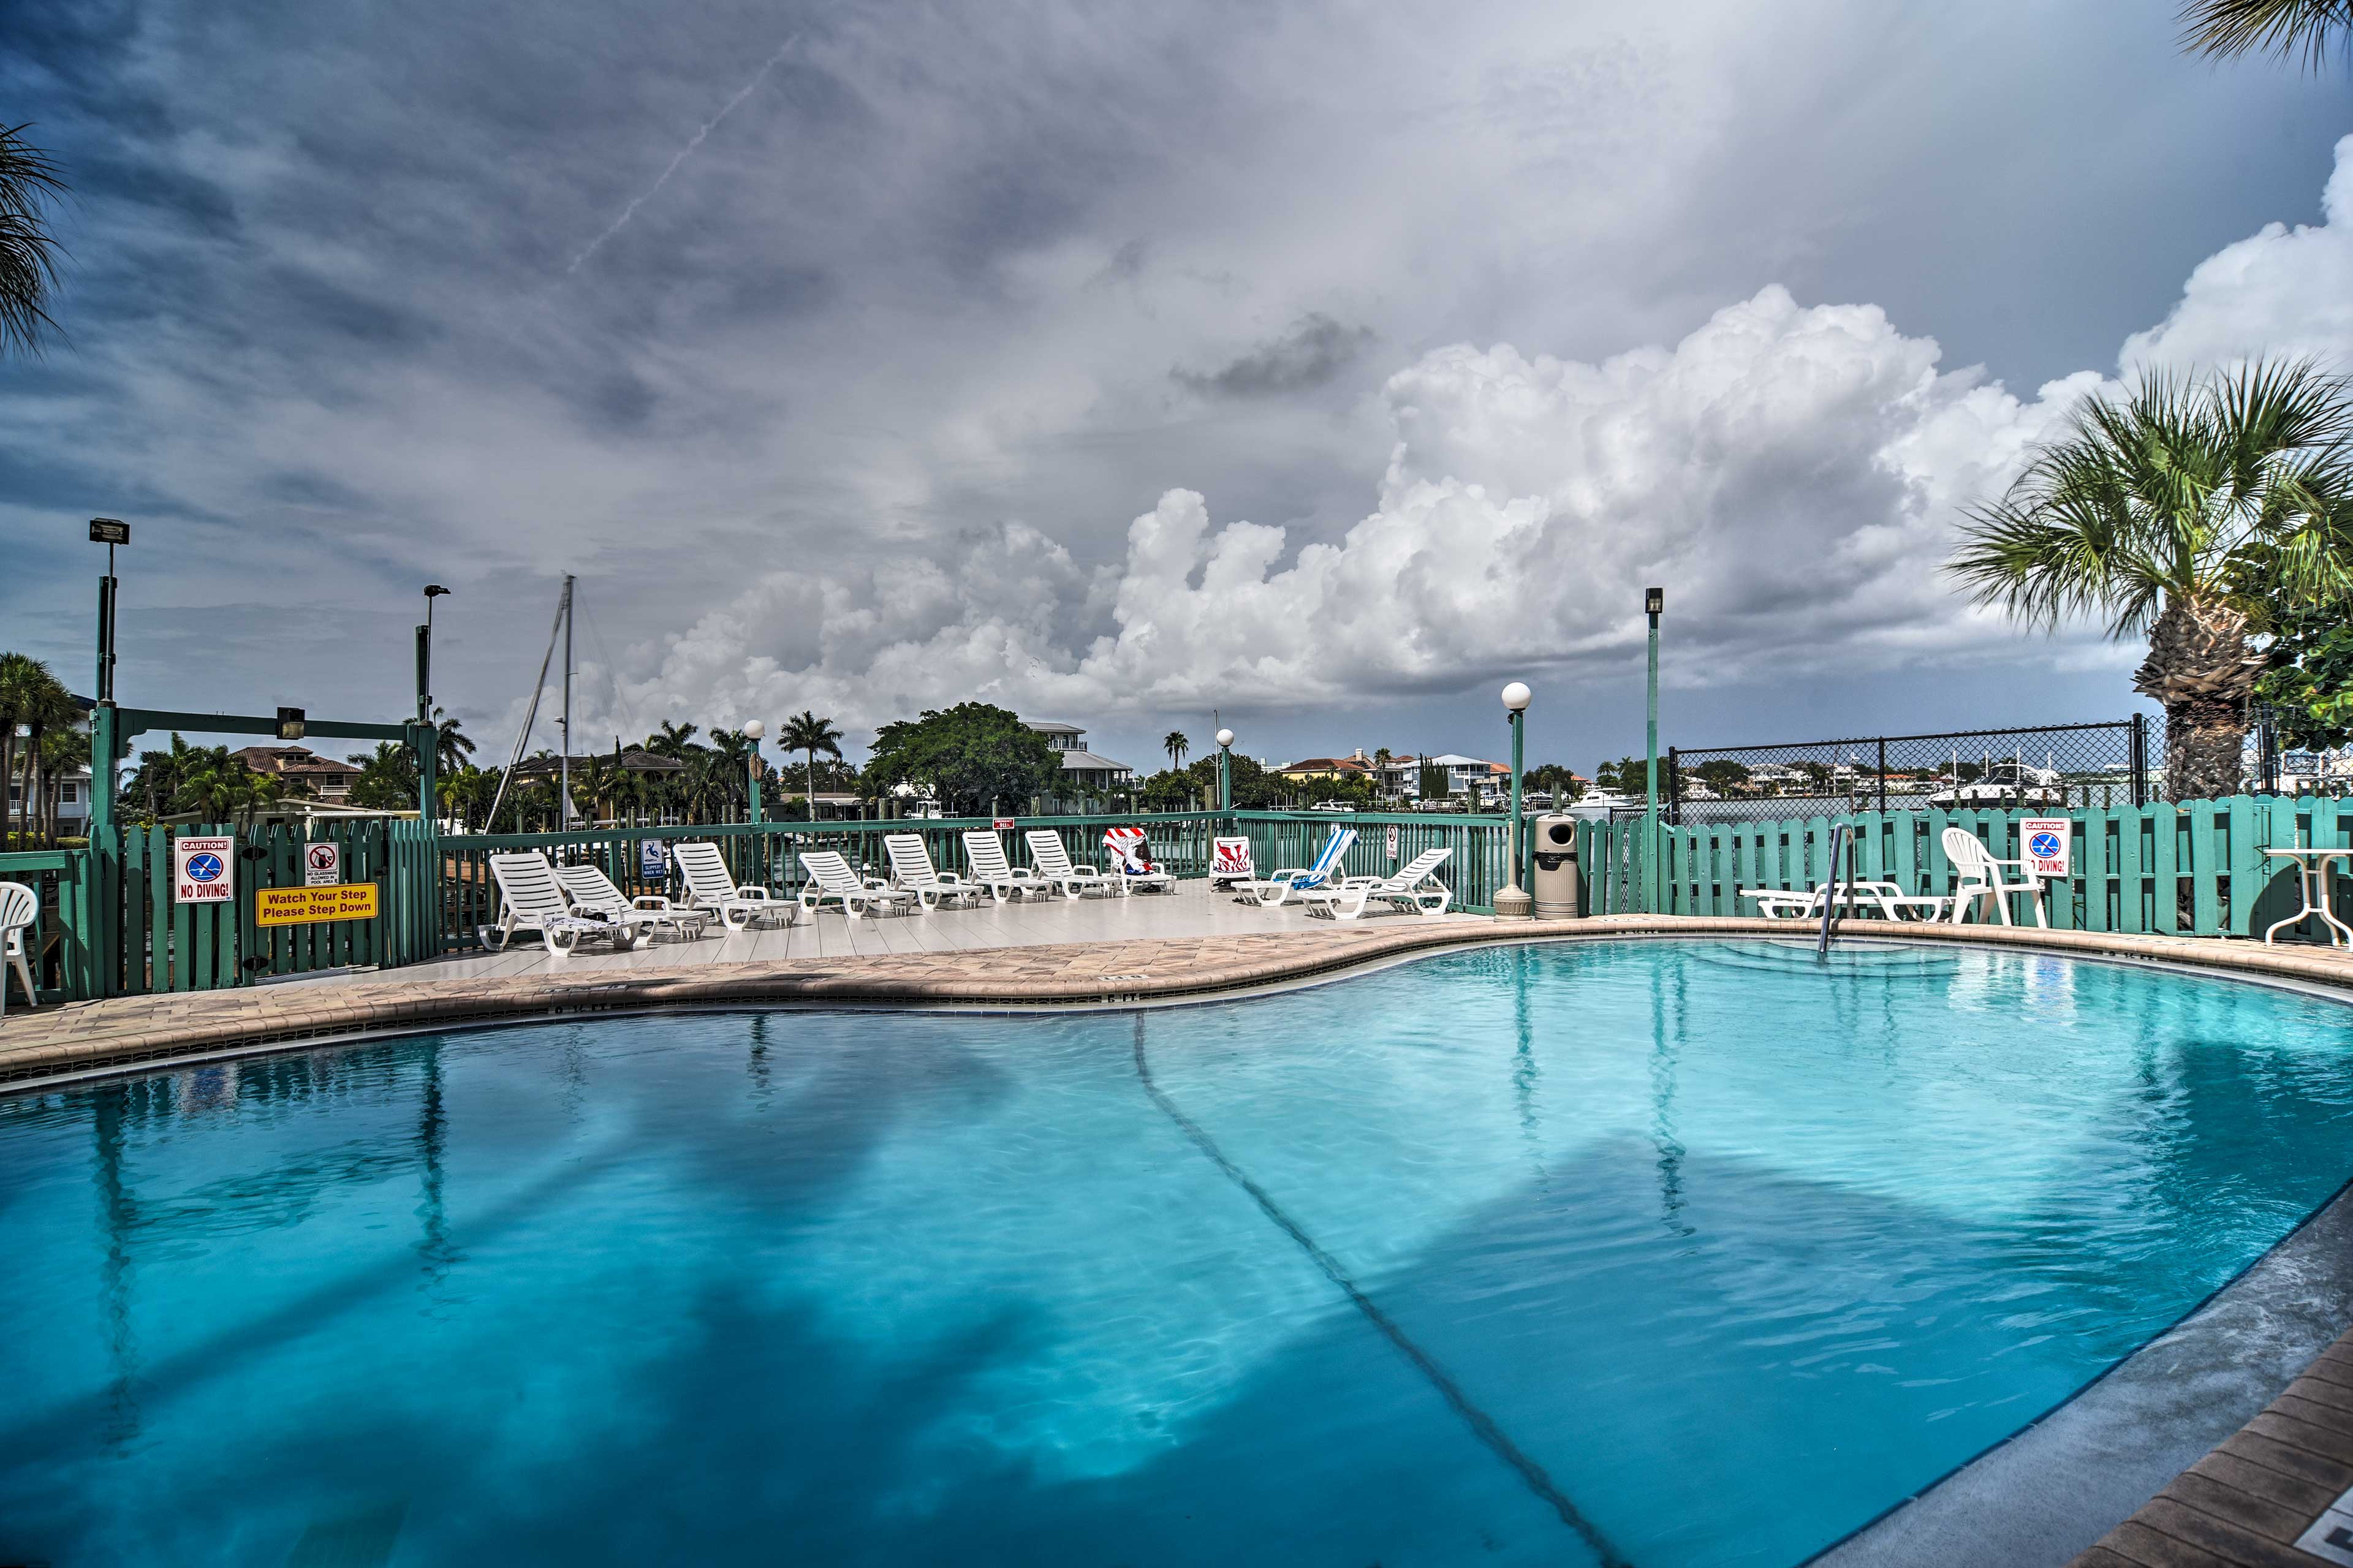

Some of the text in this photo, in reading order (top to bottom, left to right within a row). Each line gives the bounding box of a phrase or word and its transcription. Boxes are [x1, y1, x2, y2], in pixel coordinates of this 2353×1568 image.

[2039, 860, 2064, 872] DIVING!
[181, 883, 229, 898] NO DIVING!
[268, 890, 366, 904] Watch Your Step
[263, 903, 371, 918] Please Step Down
